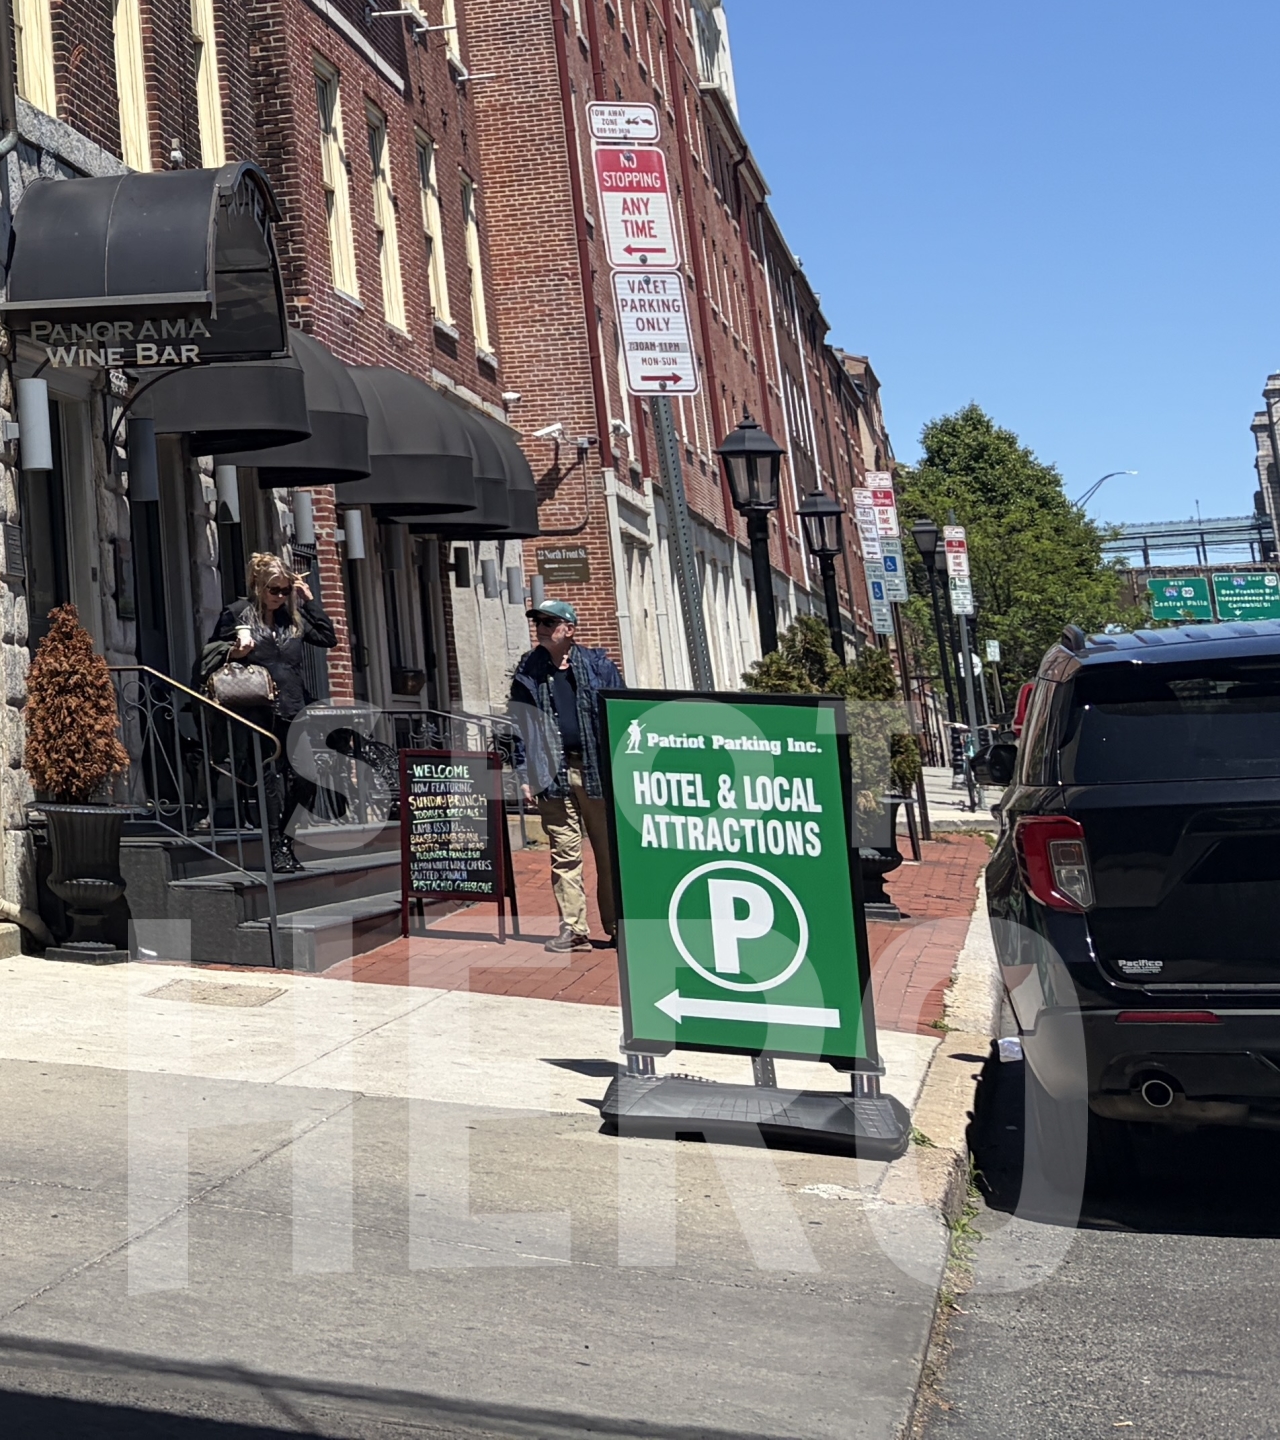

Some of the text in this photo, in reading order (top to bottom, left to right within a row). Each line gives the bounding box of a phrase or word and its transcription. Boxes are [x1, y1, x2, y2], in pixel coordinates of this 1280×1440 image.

[619, 151, 637, 168] NO
[602, 171, 661, 188] STOPPING
[621, 197, 650, 216] ANY
[621, 219, 657, 238] TIME
[627, 279, 667, 294] VALET
[620, 298, 681, 313] PARKING
[30, 318, 212, 343] PANORAMA
[635, 317, 670, 332] ONLY
[45, 342, 201, 368] WINE BAR
[641, 356, 678, 366] MON-SUN
[545, 549, 562, 559] North
[647, 732, 823, 756] Patriot Parking Inc.
[430, 781, 472, 793] FEATURING
[632, 771, 823, 813] HOTEL & LOCAL
[408, 793, 488, 810] SUNDAY BRUNCH
[413, 808, 479, 819] TODAY'S SPECIALS
[641, 814, 822, 858] ATTRACTIONS
[412, 880, 453, 891] PISTACHIO
[707, 878, 775, 975] P
[1117, 959, 1164, 967] Pacifico
